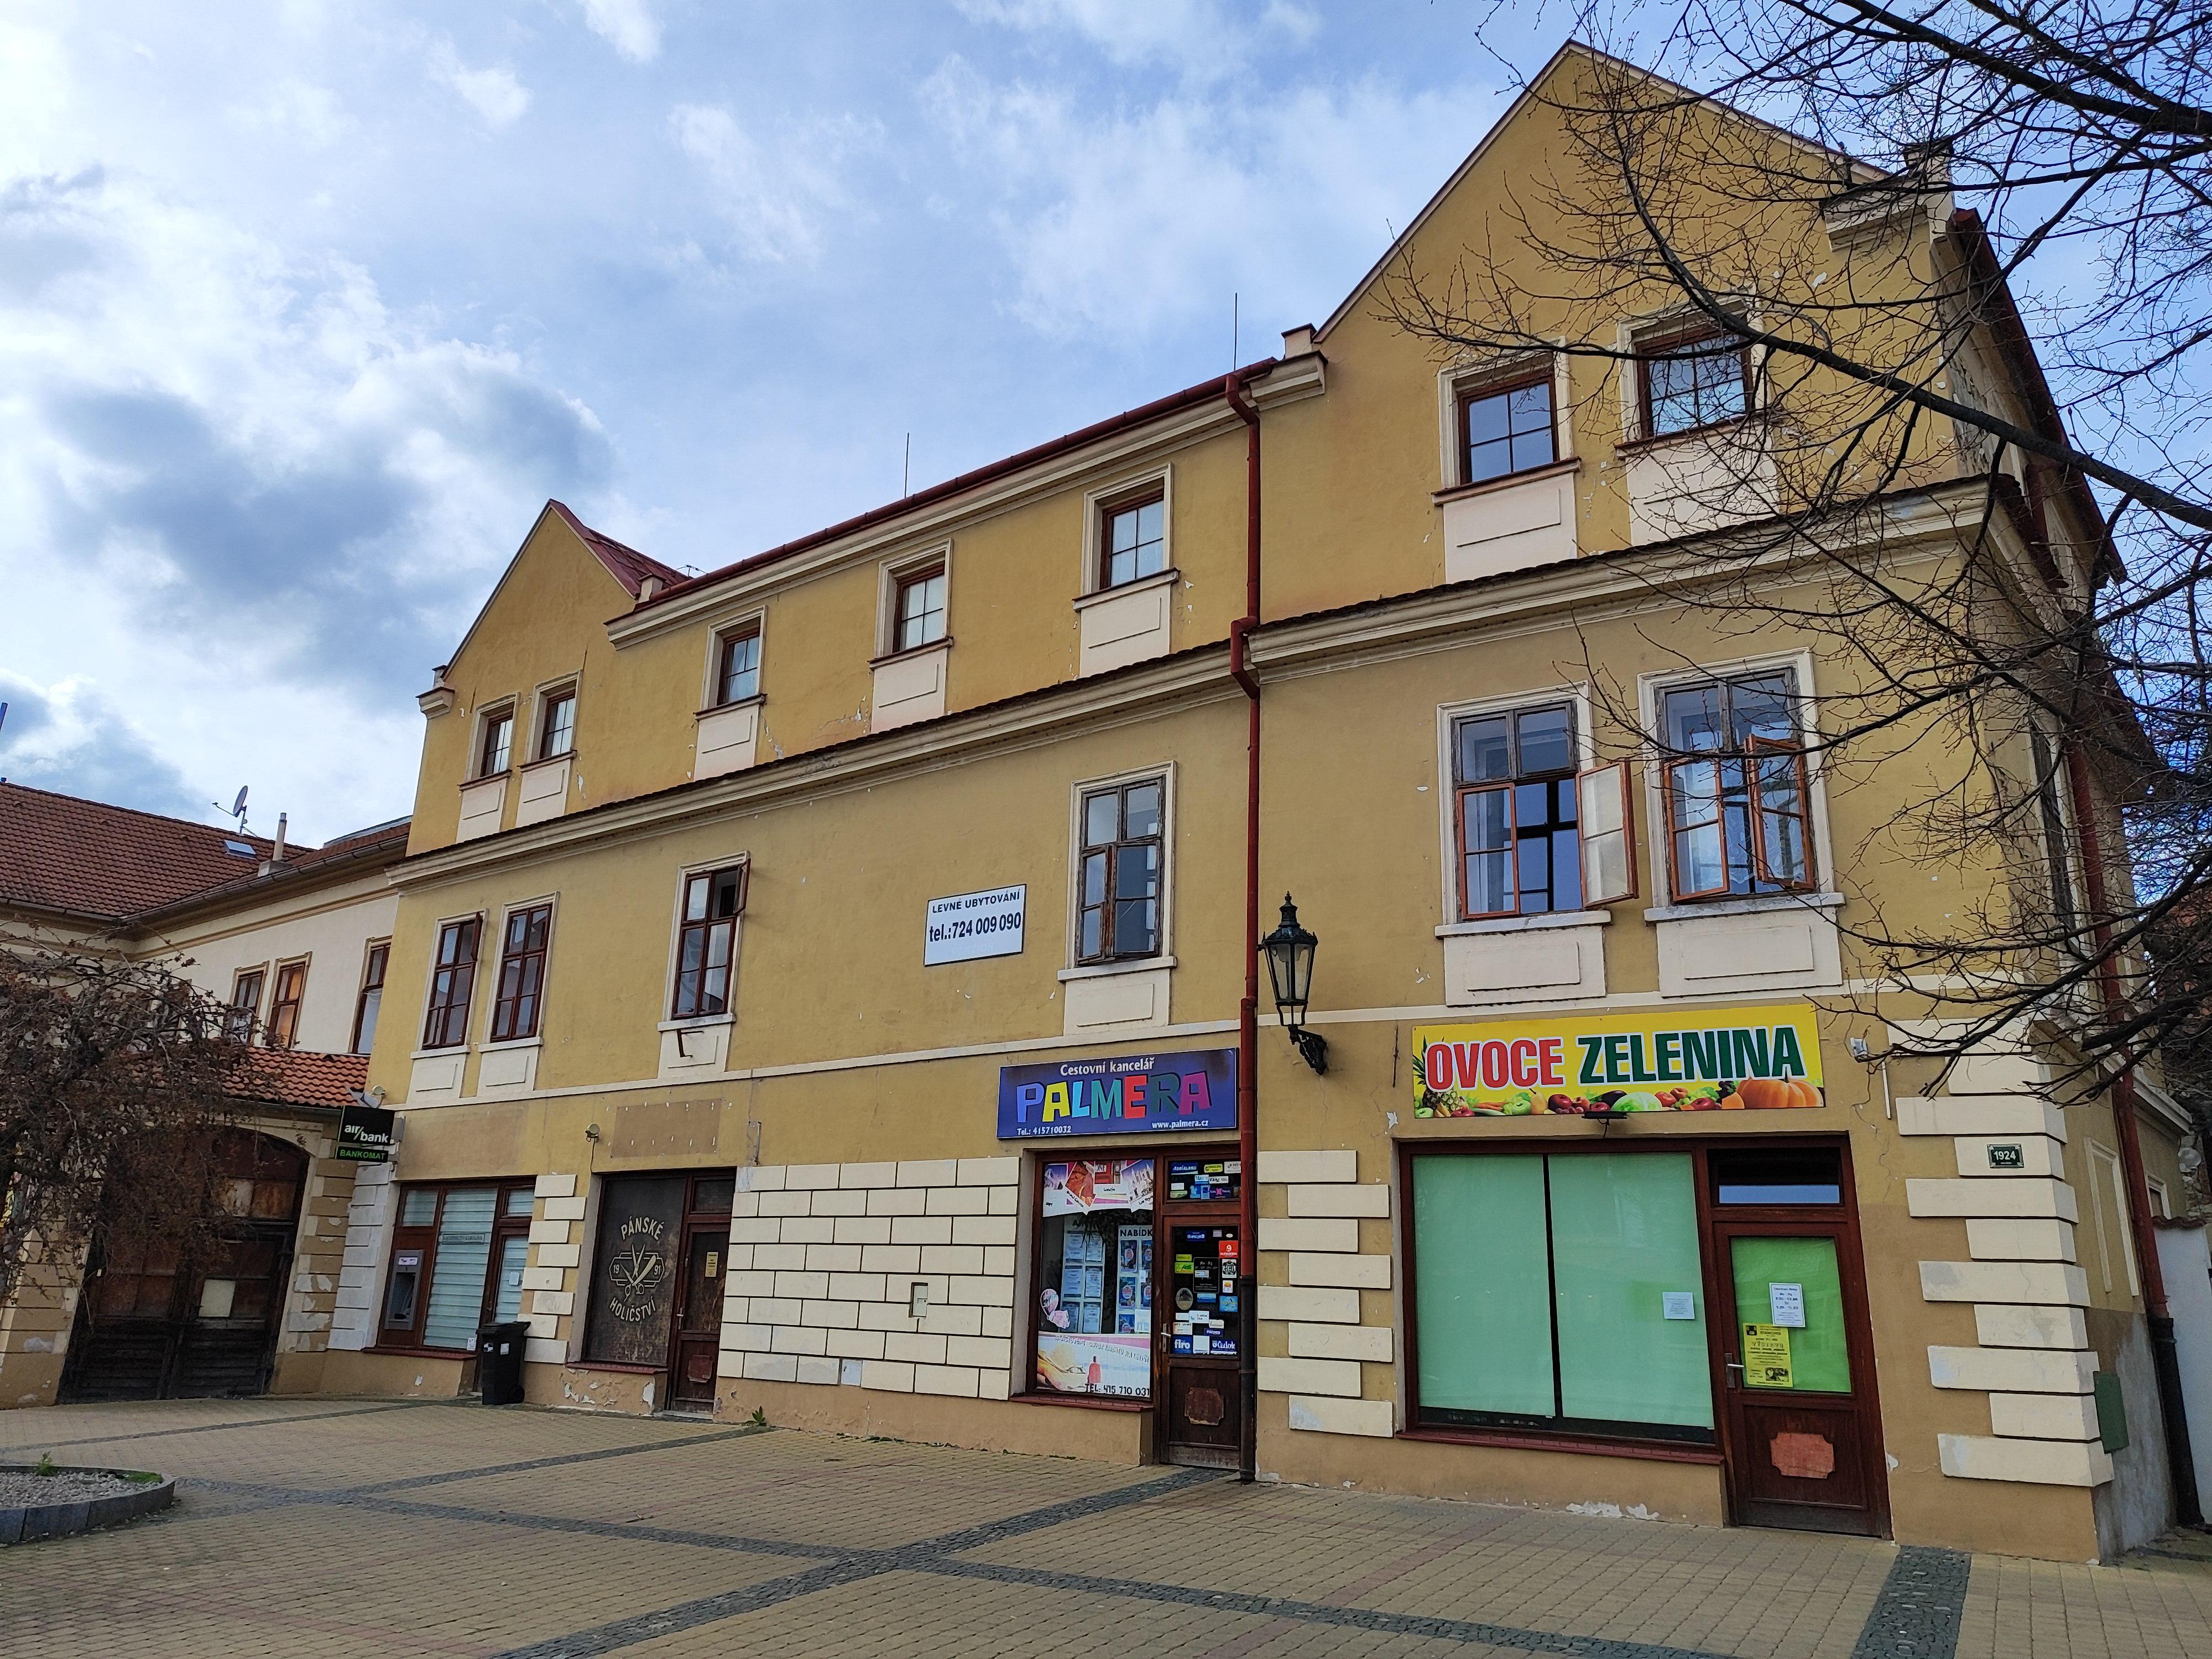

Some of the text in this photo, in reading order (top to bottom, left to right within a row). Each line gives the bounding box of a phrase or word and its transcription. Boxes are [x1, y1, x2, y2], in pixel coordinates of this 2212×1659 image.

[932, 889, 1020, 914] LEVNÉ UBYTOVÁNÍ
[975, 916, 997, 935] 009
[999, 912, 1021, 931] 090
[1426, 1026, 1806, 1091] OVOCE ZELENINA
[1060, 1057, 1155, 1076] Cestovní kancelář
[1016, 1071, 1211, 1123] PALMERA
[1032, 1125, 1072, 1135] 415710032
[1151, 1119, 1209, 1129] www.palmera.cz
[340, 1149, 385, 1160] BANKOMAT
[1994, 1150, 2016, 1161] 1924
[620, 1215, 665, 1241] PÁNSKÉ
[613, 1264, 661, 1275] 19 91
[609, 1296, 656, 1322] HOLIČSTVÍ
[1174, 1339, 1191, 1349] firo
[1085, 1383, 1101, 1392] TEL:
[1103, 1385, 1116, 1395] 415
[1119, 1386, 1133, 1394] 710
